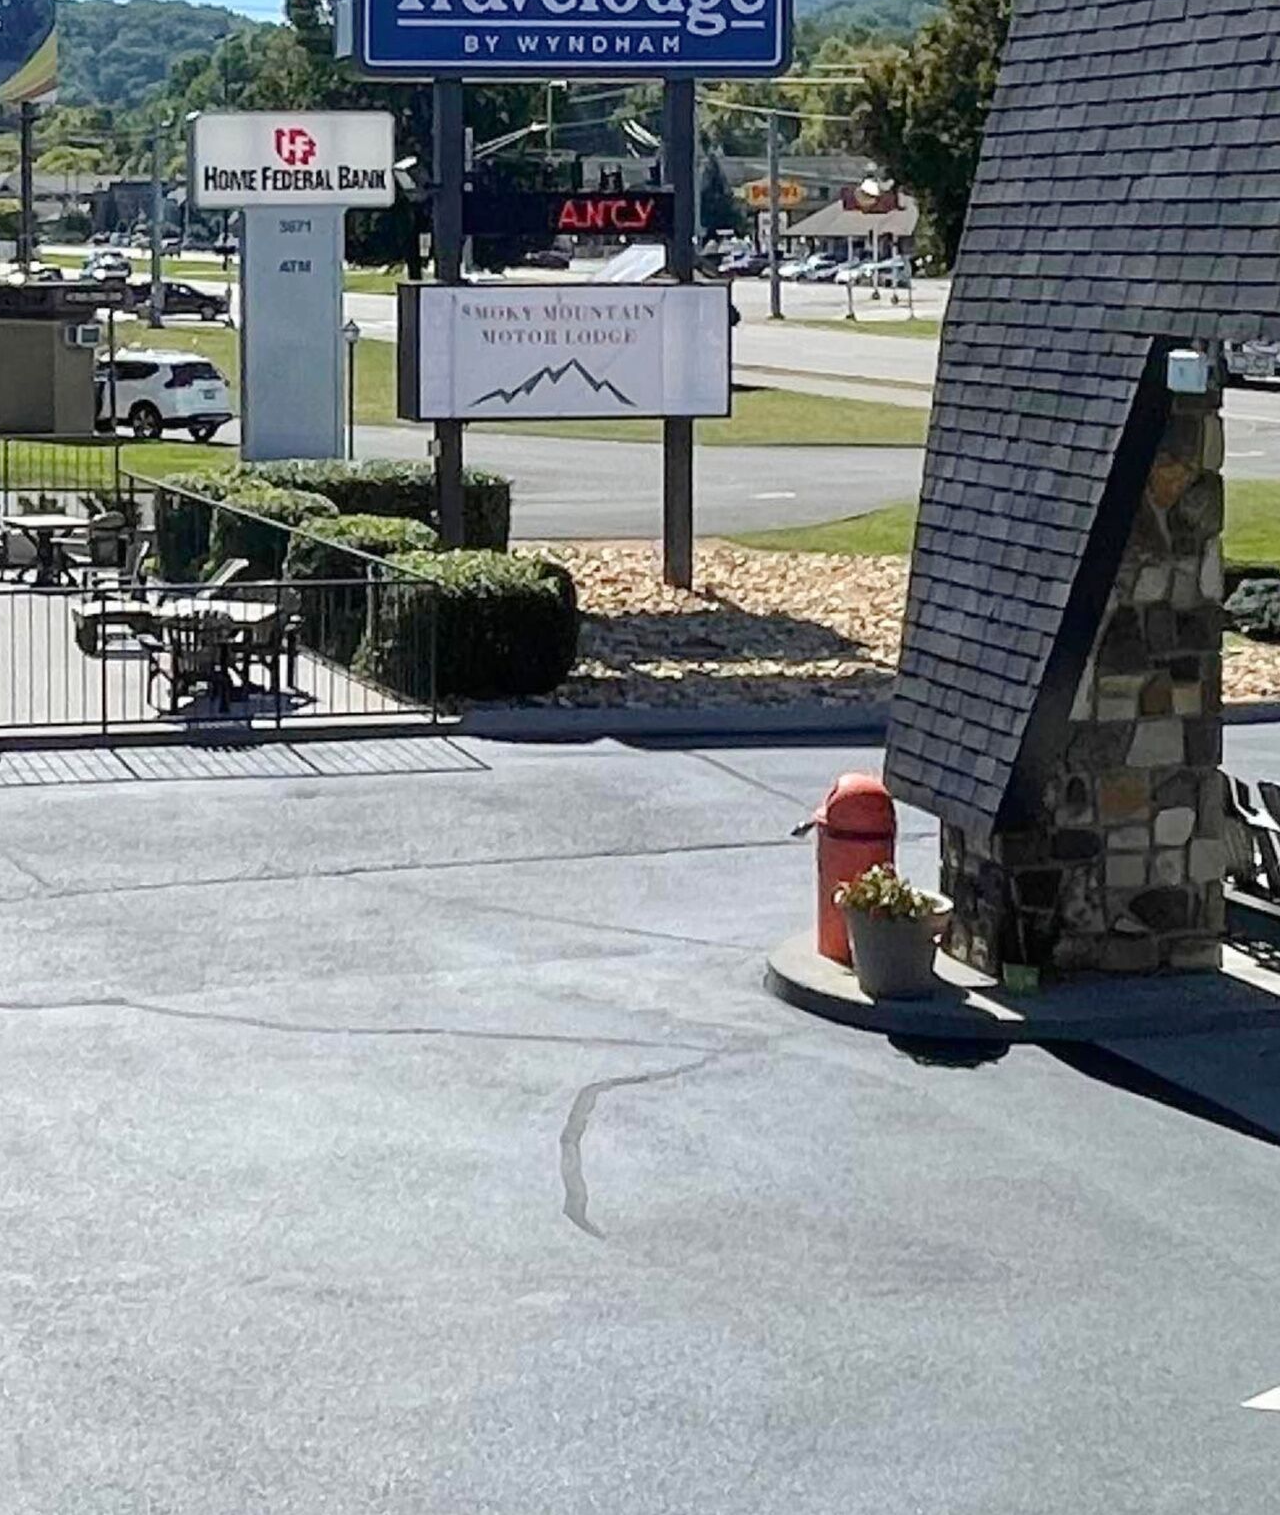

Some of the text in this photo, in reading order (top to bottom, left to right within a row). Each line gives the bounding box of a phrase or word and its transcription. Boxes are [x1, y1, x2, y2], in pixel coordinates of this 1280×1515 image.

[464, 34, 682, 54] BY WYNDHAM
[460, 304, 655, 321] SMOKY MOUNTAIN
[482, 329, 638, 345] MOTOR LODGE
